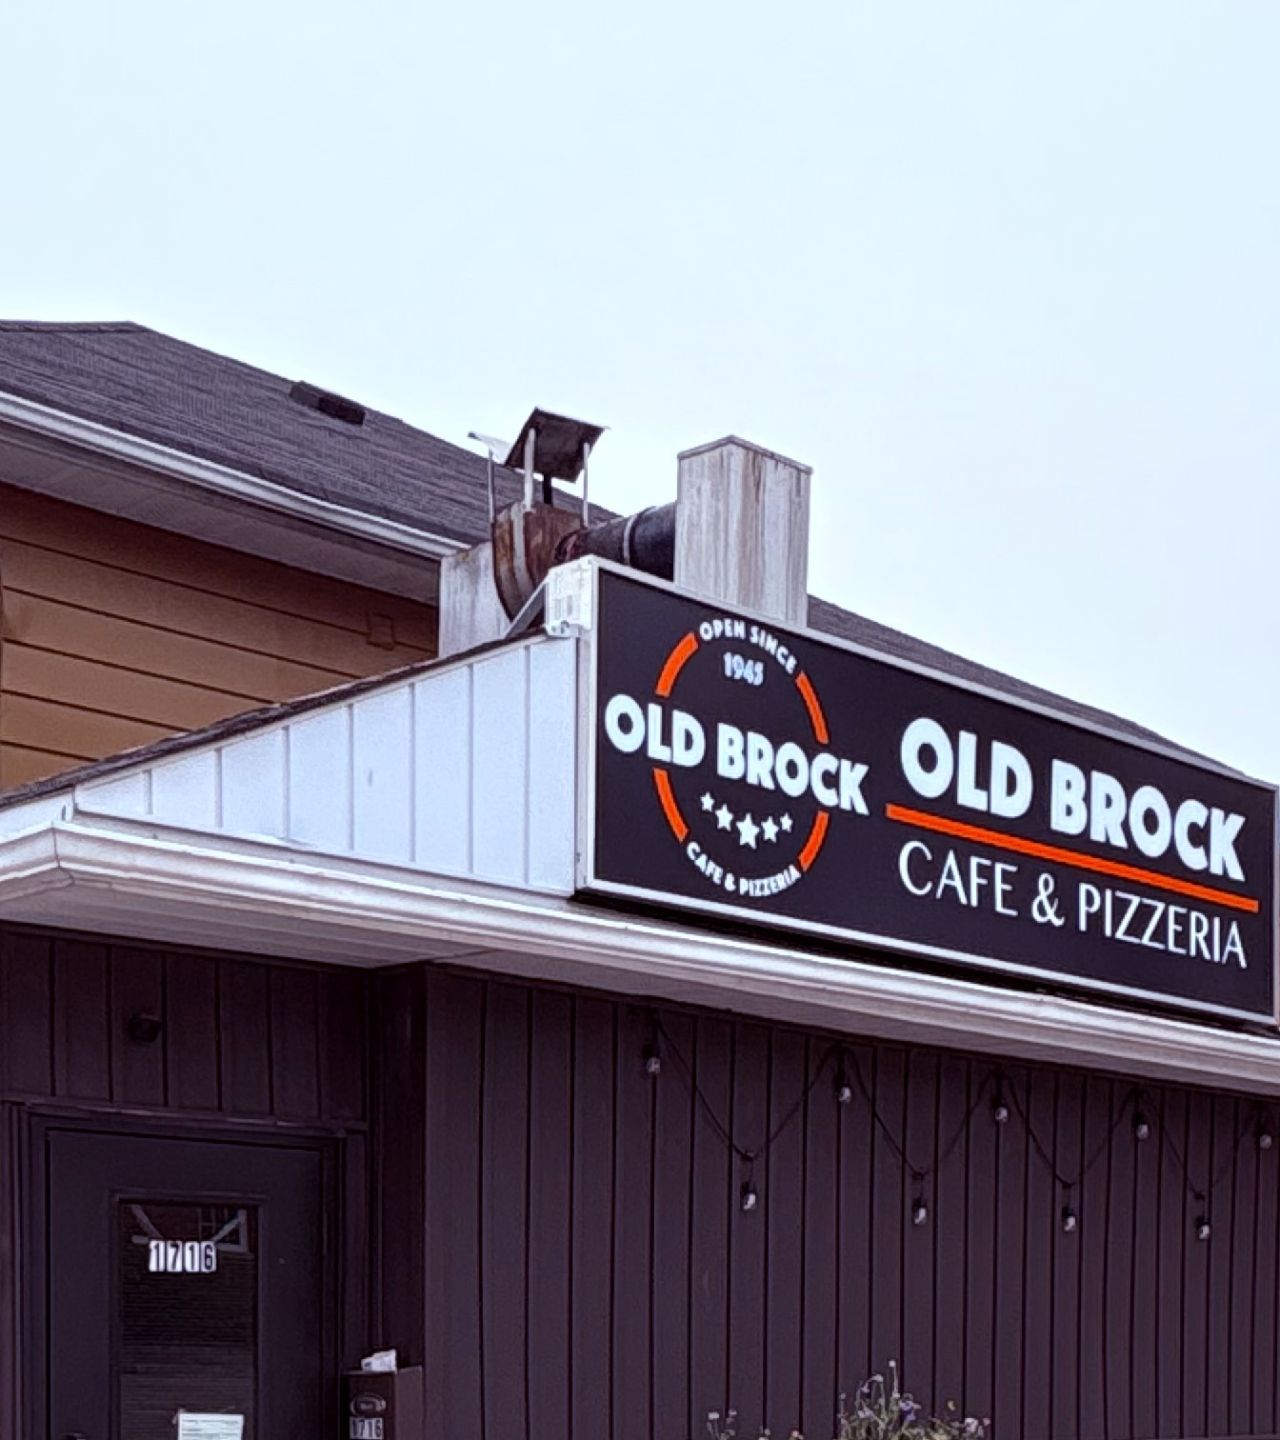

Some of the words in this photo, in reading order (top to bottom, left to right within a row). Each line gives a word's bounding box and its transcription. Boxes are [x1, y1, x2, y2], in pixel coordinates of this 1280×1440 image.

[699, 618, 746, 641] OPEN
[750, 625, 798, 674] SINCE
[723, 652, 764, 686] 1945
[605, 693, 706, 768] OLD
[716, 722, 871, 816] BROCK
[900, 717, 1033, 819] OLD
[1050, 758, 1246, 882] BROCK
[686, 841, 724, 885] CAFE
[724, 873, 736, 892] &
[739, 864, 802, 897] PIZZERIA
[898, 840, 1019, 917] CAFE
[1030, 872, 1066, 927] &
[1077, 881, 1248, 969] PIZZERIA
[152, 1242, 214, 1271] 1716
